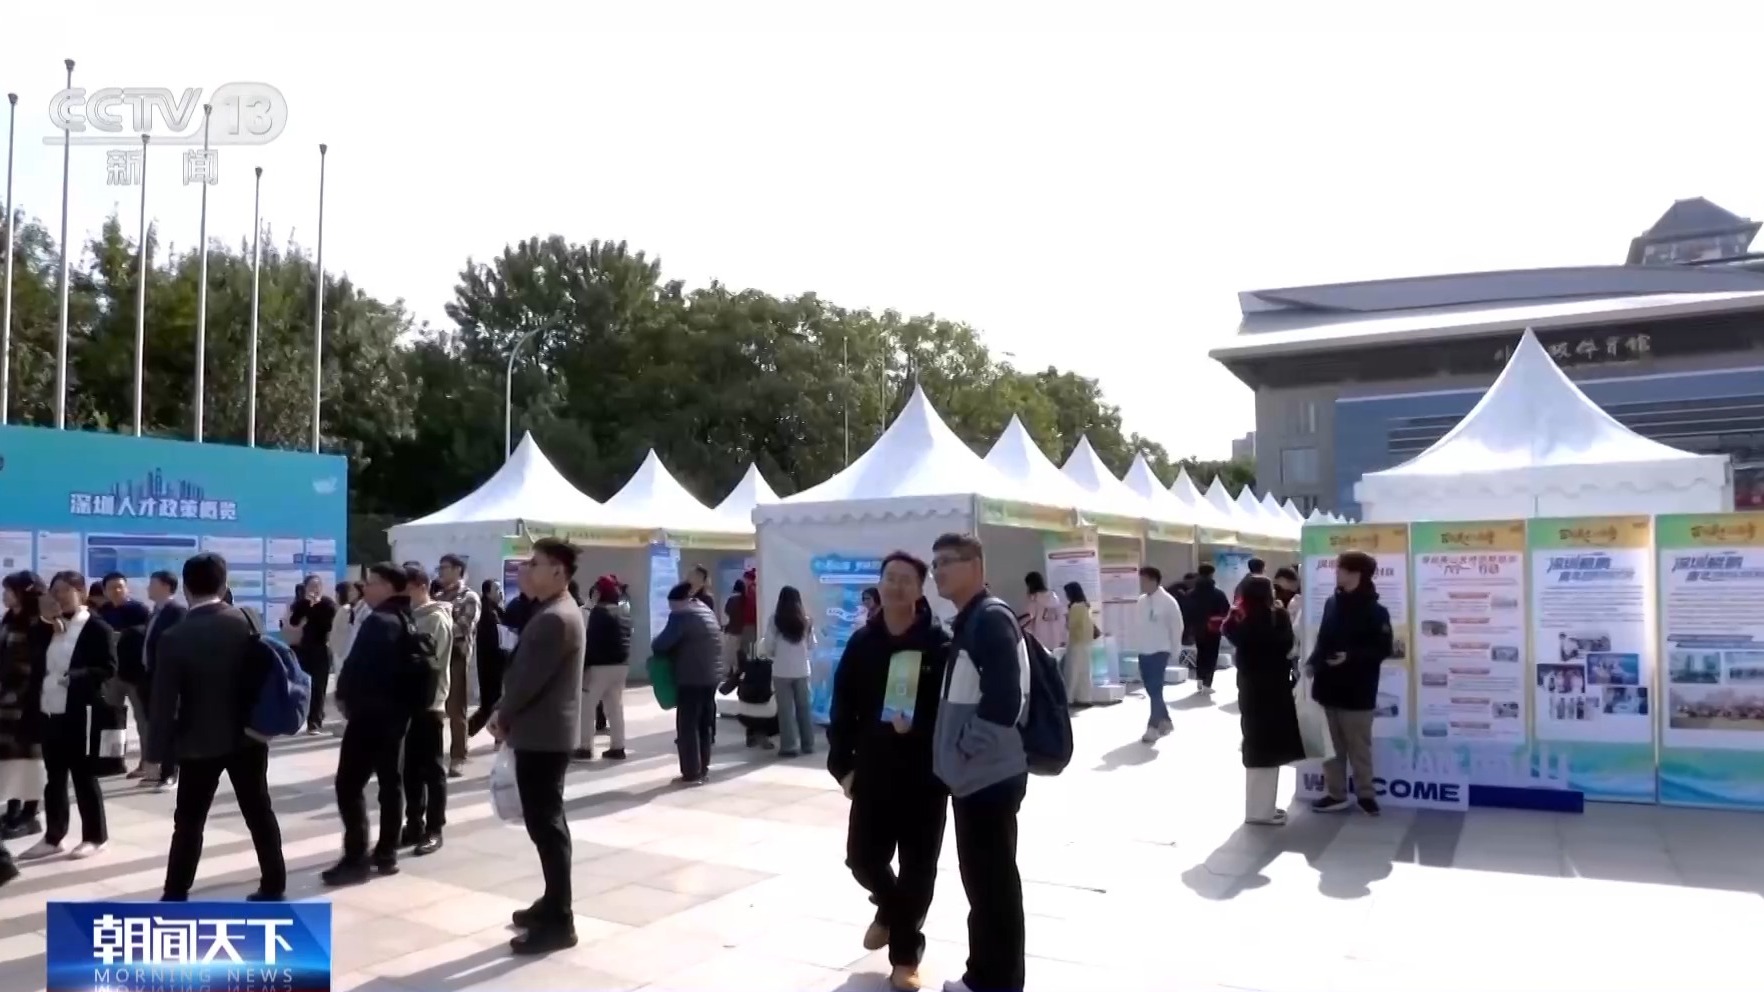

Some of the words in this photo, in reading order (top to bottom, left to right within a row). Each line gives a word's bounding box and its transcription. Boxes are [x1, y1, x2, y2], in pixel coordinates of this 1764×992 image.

[69, 492, 237, 520] 深圳人才政策概览
[1304, 773, 1461, 802] WCOME
